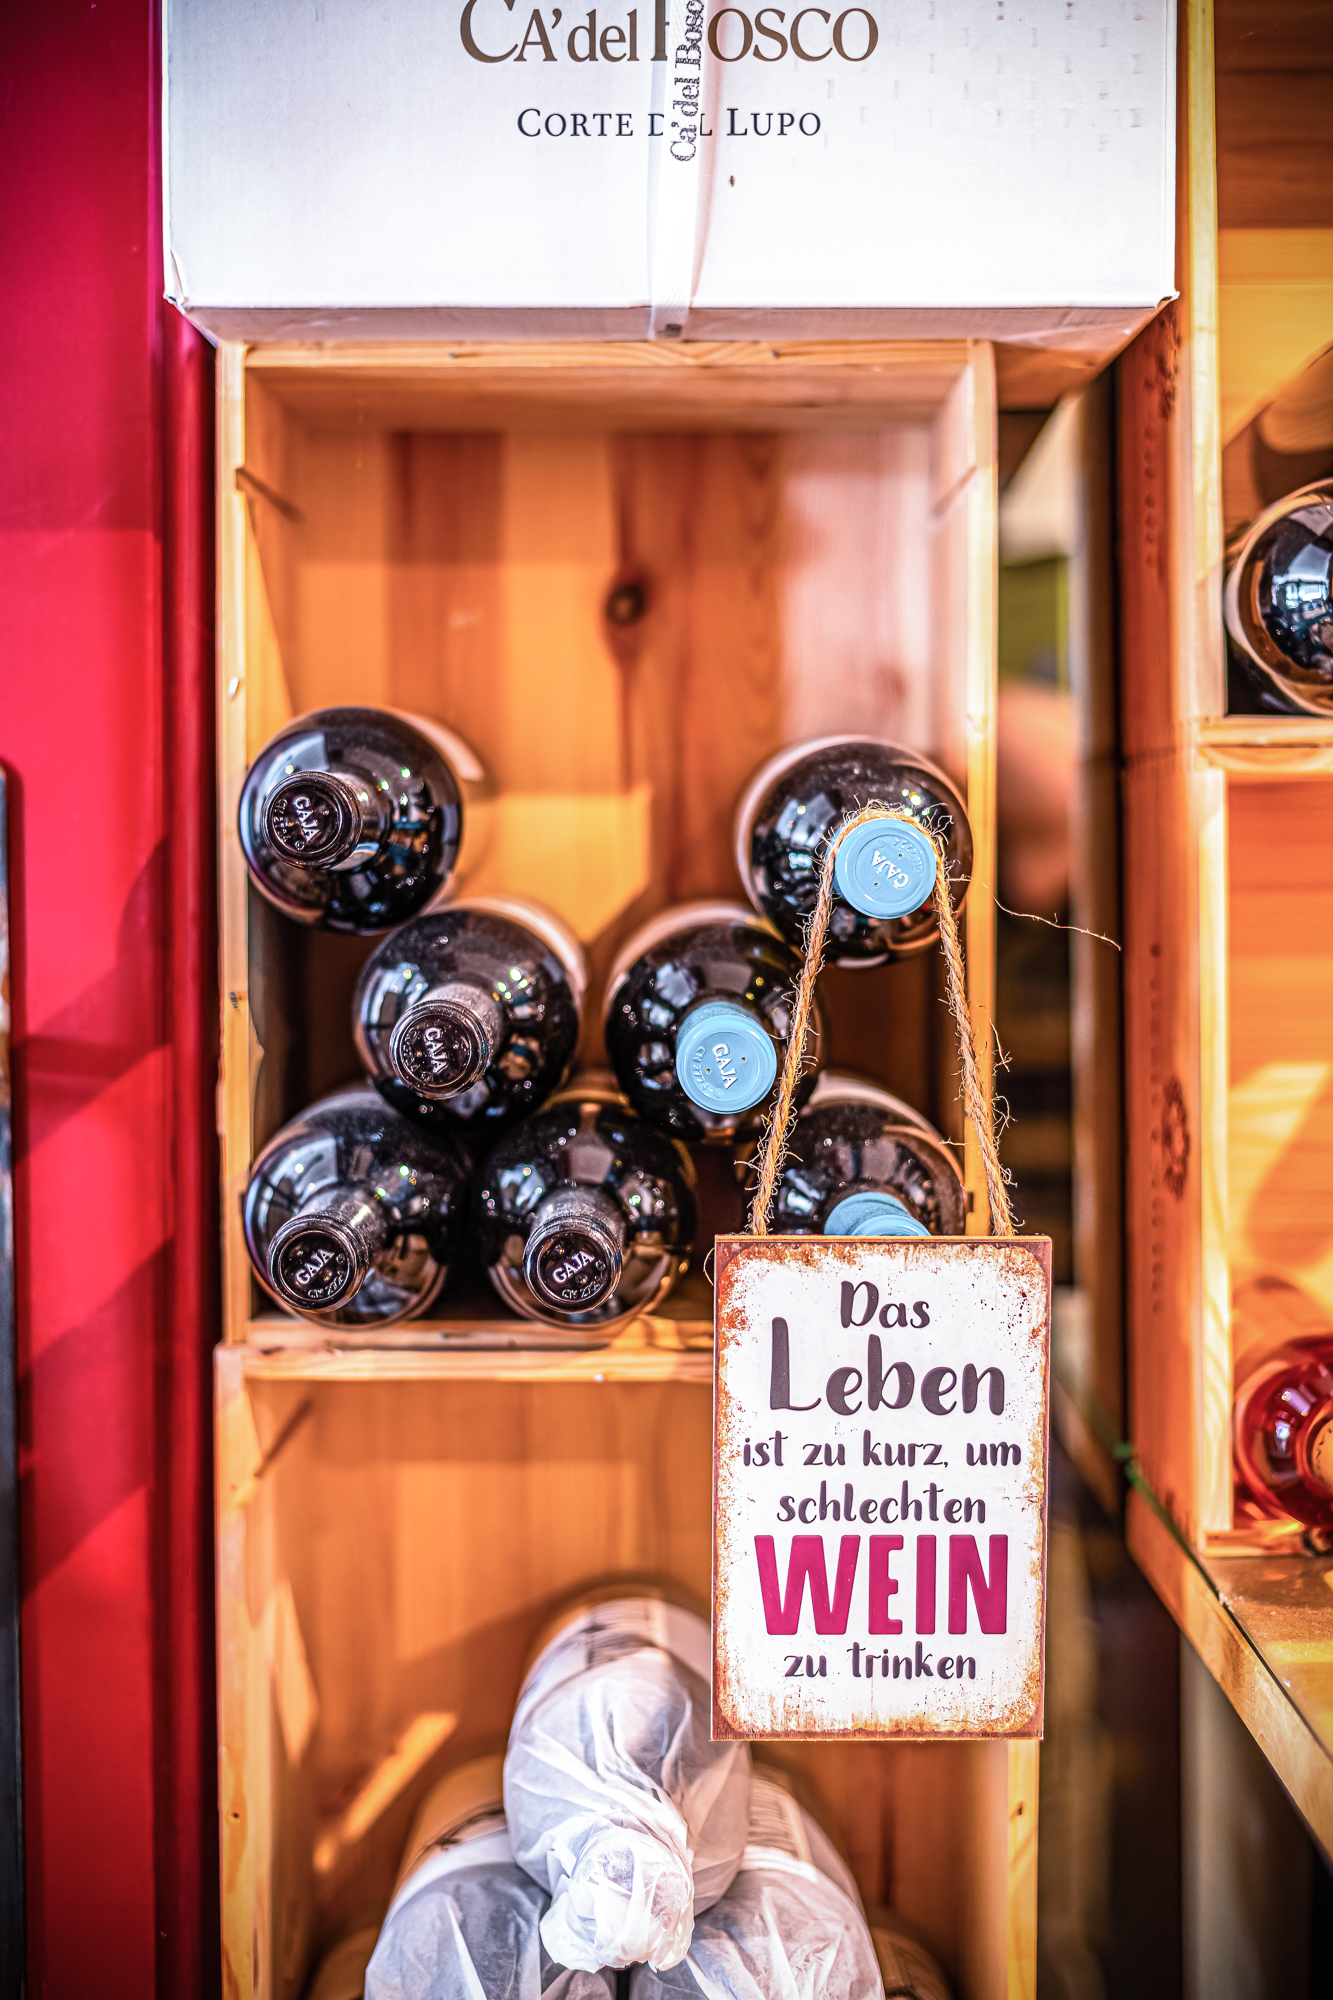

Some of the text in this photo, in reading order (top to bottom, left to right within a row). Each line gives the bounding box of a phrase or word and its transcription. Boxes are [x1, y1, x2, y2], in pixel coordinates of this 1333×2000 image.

[650, 0, 879, 63] OSCO
[675, 0, 705, 70] Bosc
[673, 77, 701, 118] del
[516, 107, 822, 138] CORTE DL LUPO
[872, 850, 910, 890] GAJA
[712, 1043, 738, 1090] GAJA
[296, 1249, 335, 1285] GAJA
[552, 1250, 595, 1285] GAJA
[840, 1280, 931, 1330] Das
[769, 1317, 1006, 1416] Leben
[743, 1429, 1022, 1469] ist zu kurz, um
[776, 1480, 987, 1524] schlechten
[754, 1534, 1009, 1635] WEIN
[784, 1641, 977, 1681] zu trinken
